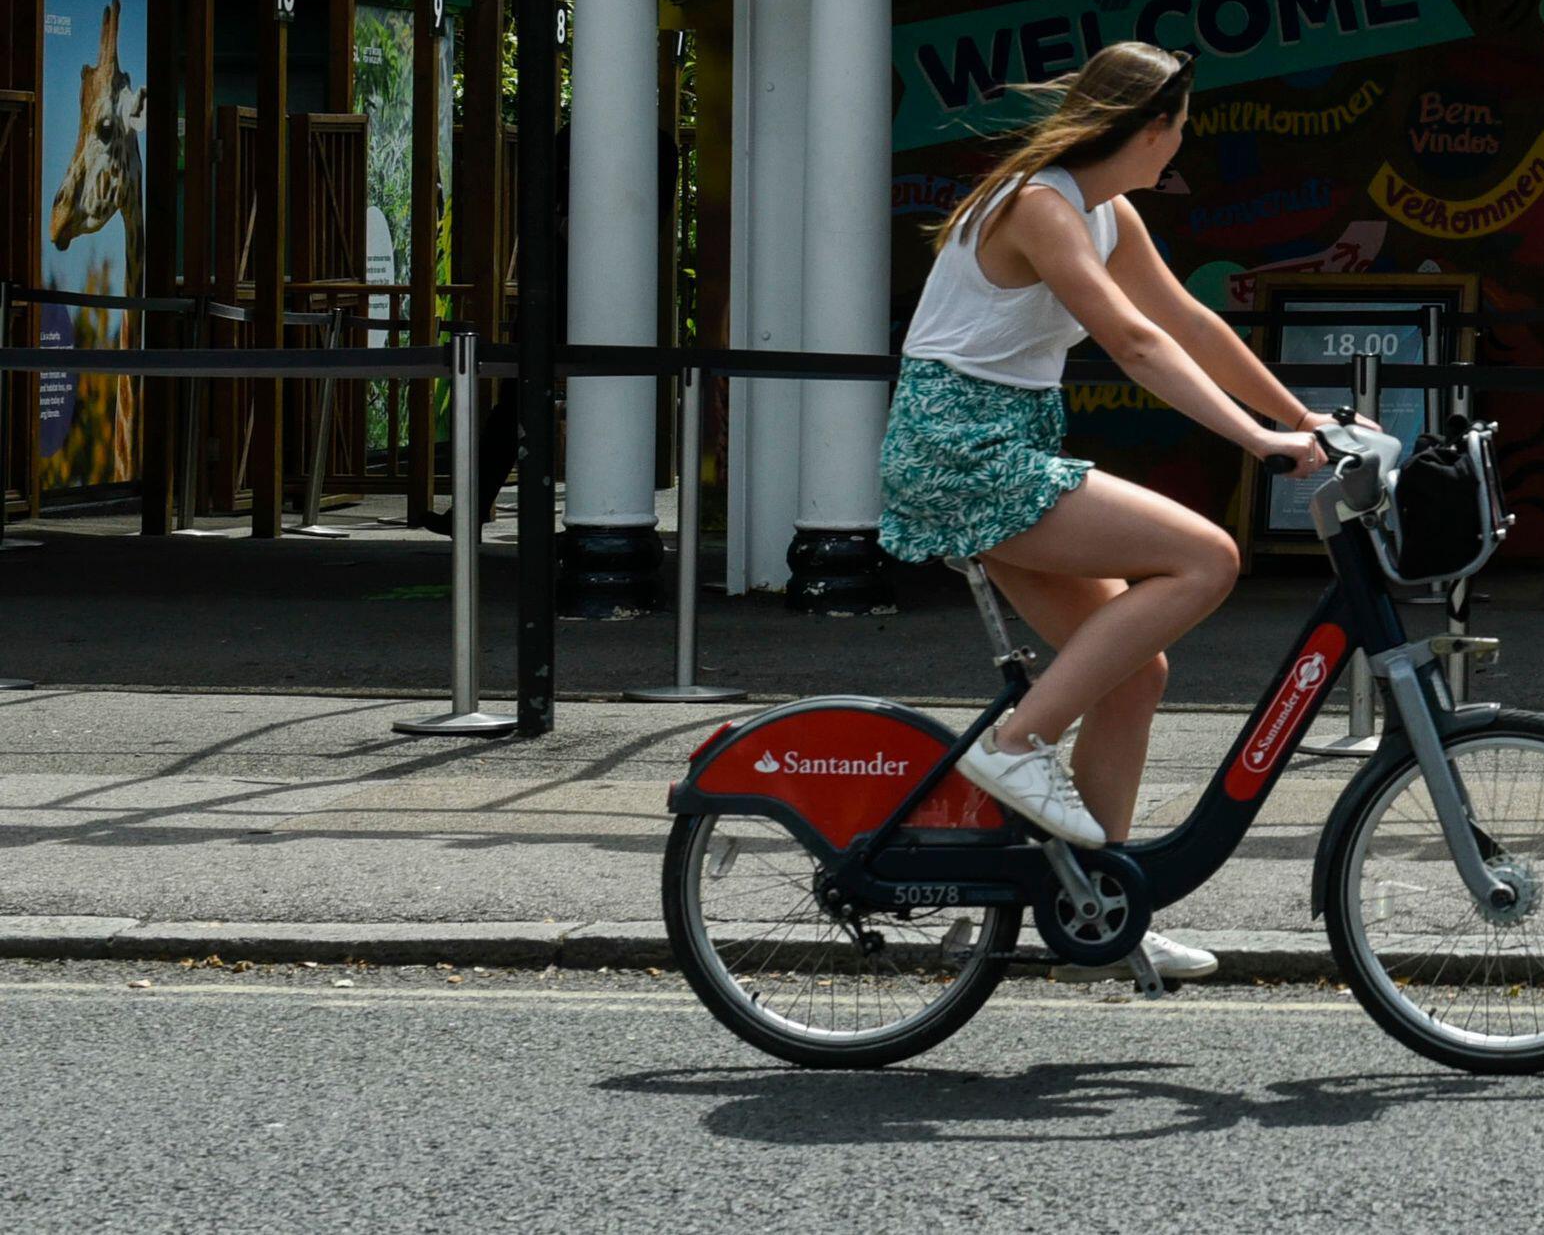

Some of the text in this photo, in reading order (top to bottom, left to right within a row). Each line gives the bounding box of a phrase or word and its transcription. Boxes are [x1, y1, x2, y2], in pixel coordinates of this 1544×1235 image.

[556, 8, 566, 45] 8
[1409, 125, 1500, 155] Vindos
[1322, 333, 1398, 356] 18.00
[1256, 691, 1300, 751] Santander
[783, 750, 909, 777] Santander
[893, 886, 960, 905] 50378
